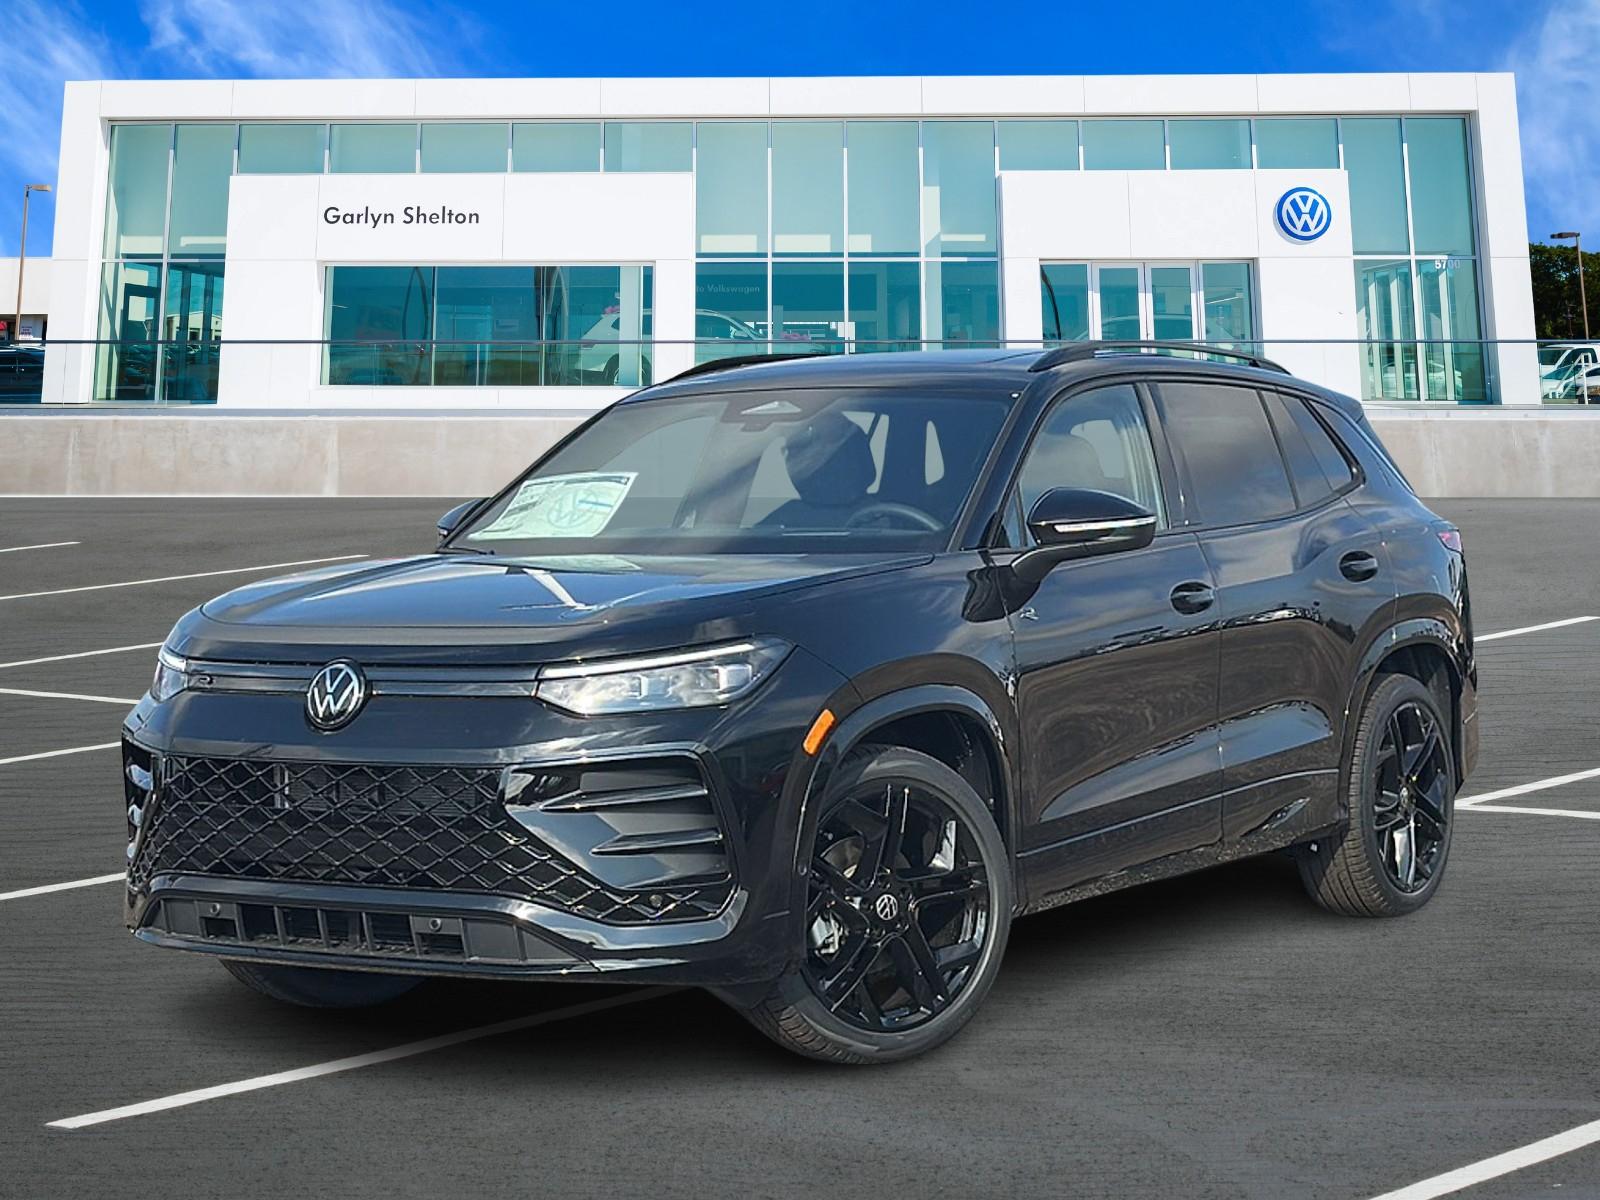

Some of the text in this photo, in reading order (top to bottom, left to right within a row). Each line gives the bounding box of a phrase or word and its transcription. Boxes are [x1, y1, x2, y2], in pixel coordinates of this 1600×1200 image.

[323, 205, 480, 229] Garlyn Shelton
[1434, 259, 1461, 270] 5700
[707, 283, 760, 295] Volkswagen
[307, 660, 363, 727] VW
